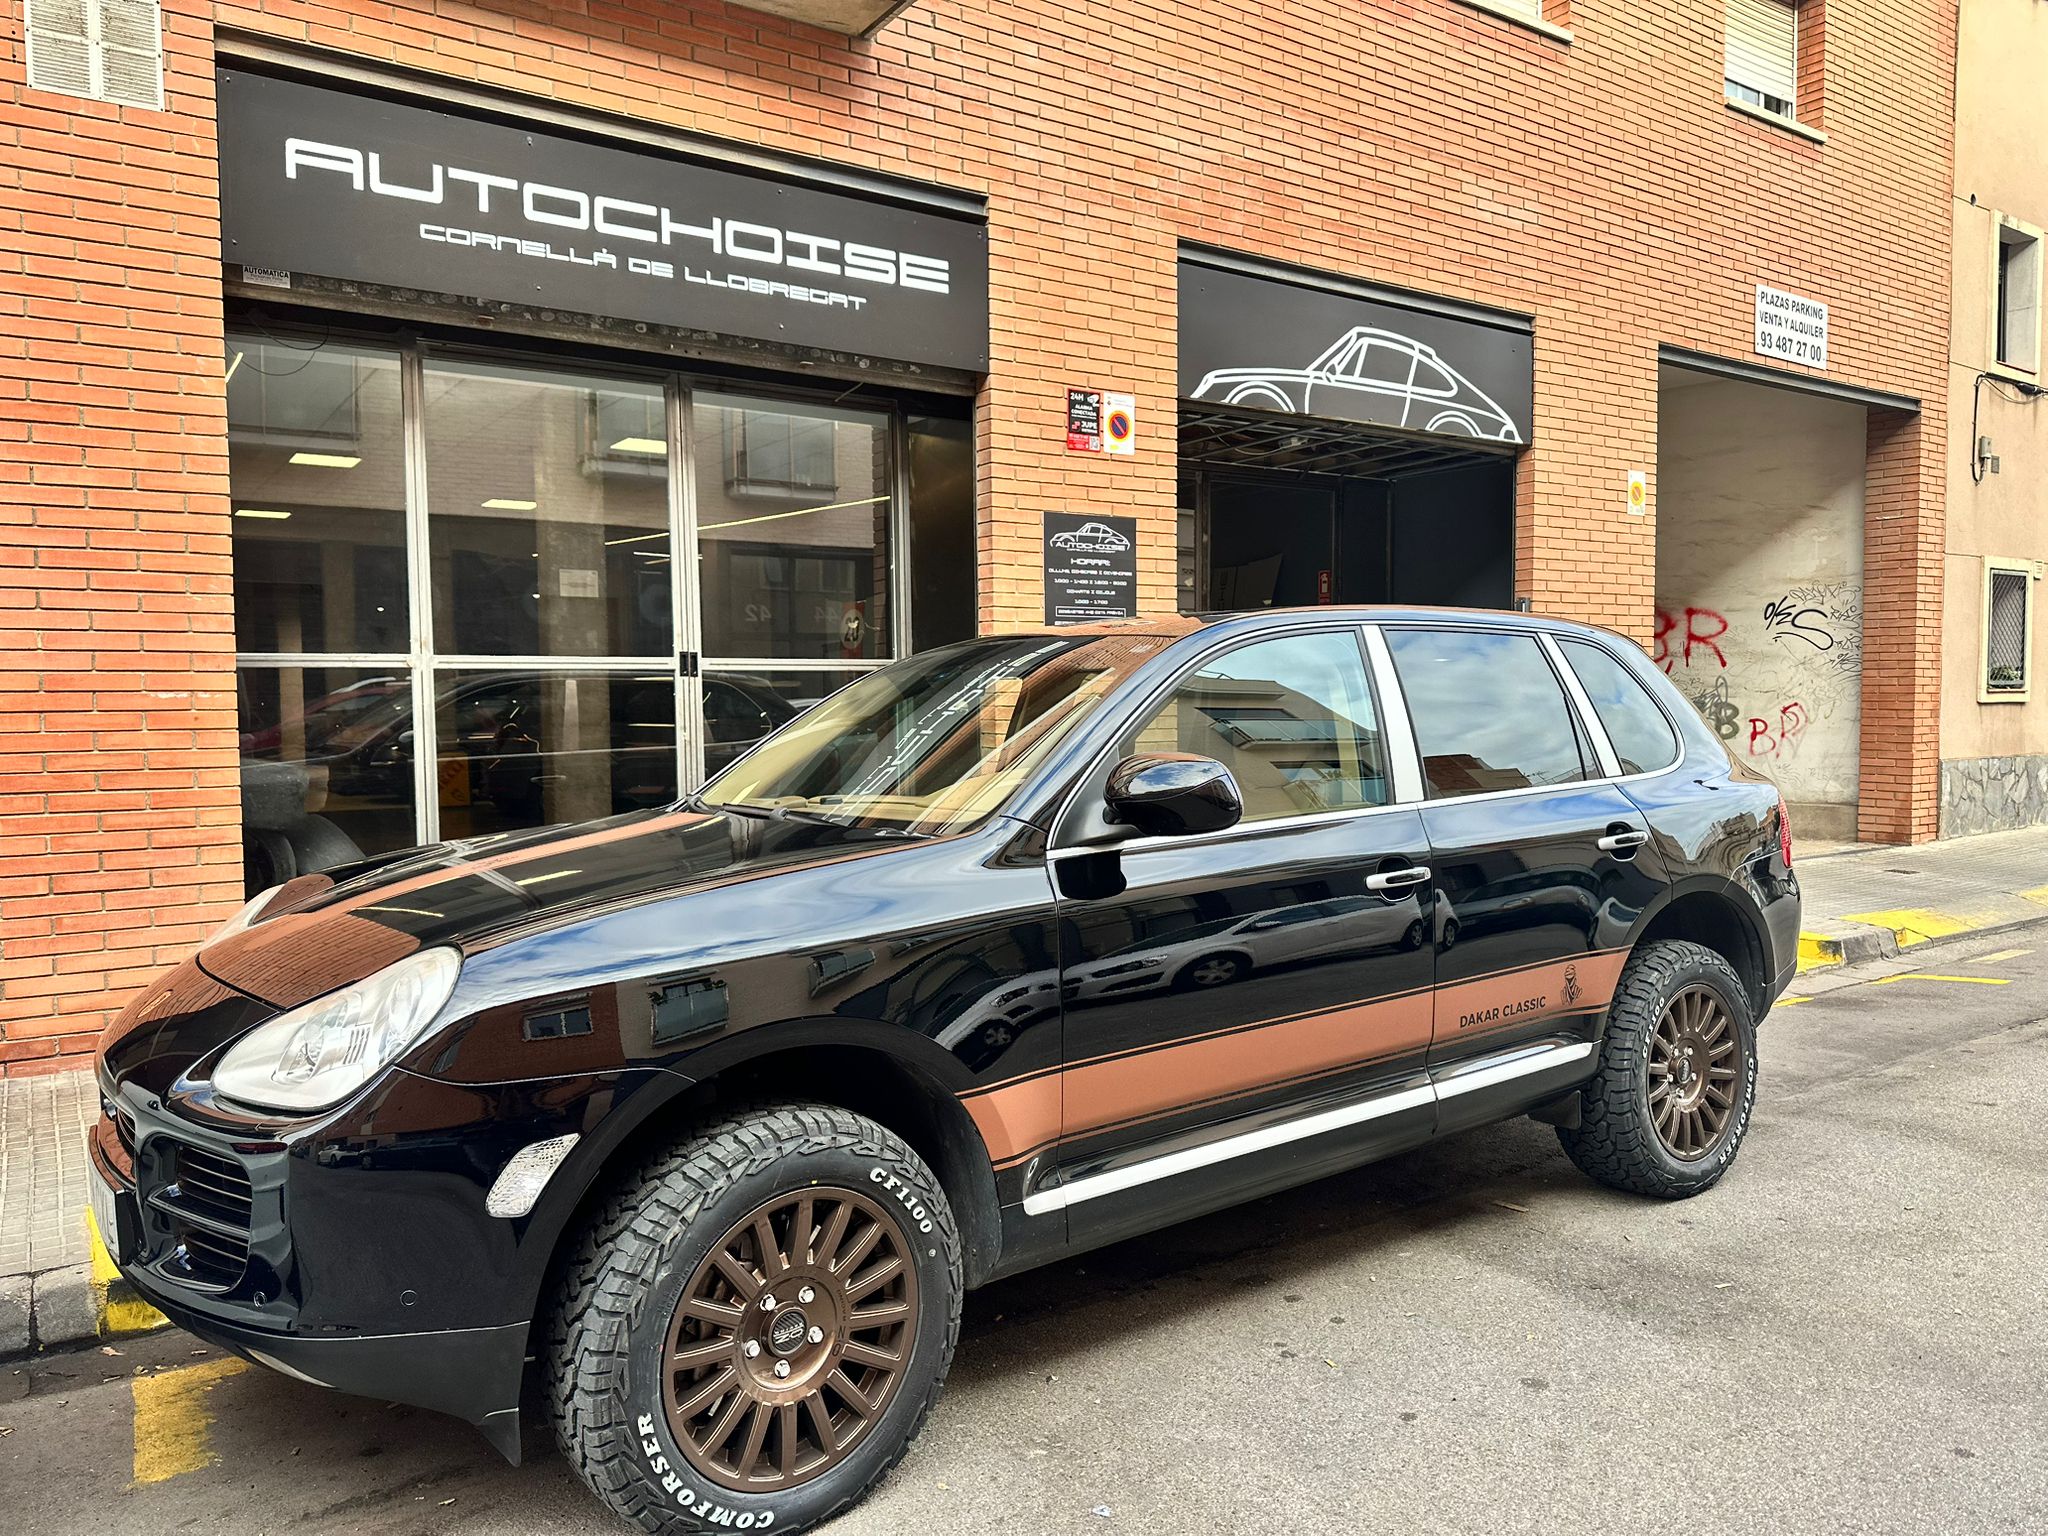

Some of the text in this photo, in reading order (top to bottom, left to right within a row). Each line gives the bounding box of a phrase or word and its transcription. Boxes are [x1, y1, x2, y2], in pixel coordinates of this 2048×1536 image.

[284, 137, 950, 294] AUTOCHOISE
[628, 259, 674, 278] DE
[684, 266, 867, 311] LLOBREGAT
[1760, 291, 1823, 320] PLAZAS PARKING
[1759, 310, 1824, 339] VENTA Y ALQUILER
[1760, 331, 1822, 361] 93 487 27 00
[1055, 541, 1126, 552] AUTOCHOISE
[1459, 996, 1547, 1028] DAKAR CLASSIC
[869, 1167, 933, 1233] CF1100
[637, 1412, 775, 1529] COMFORSER
